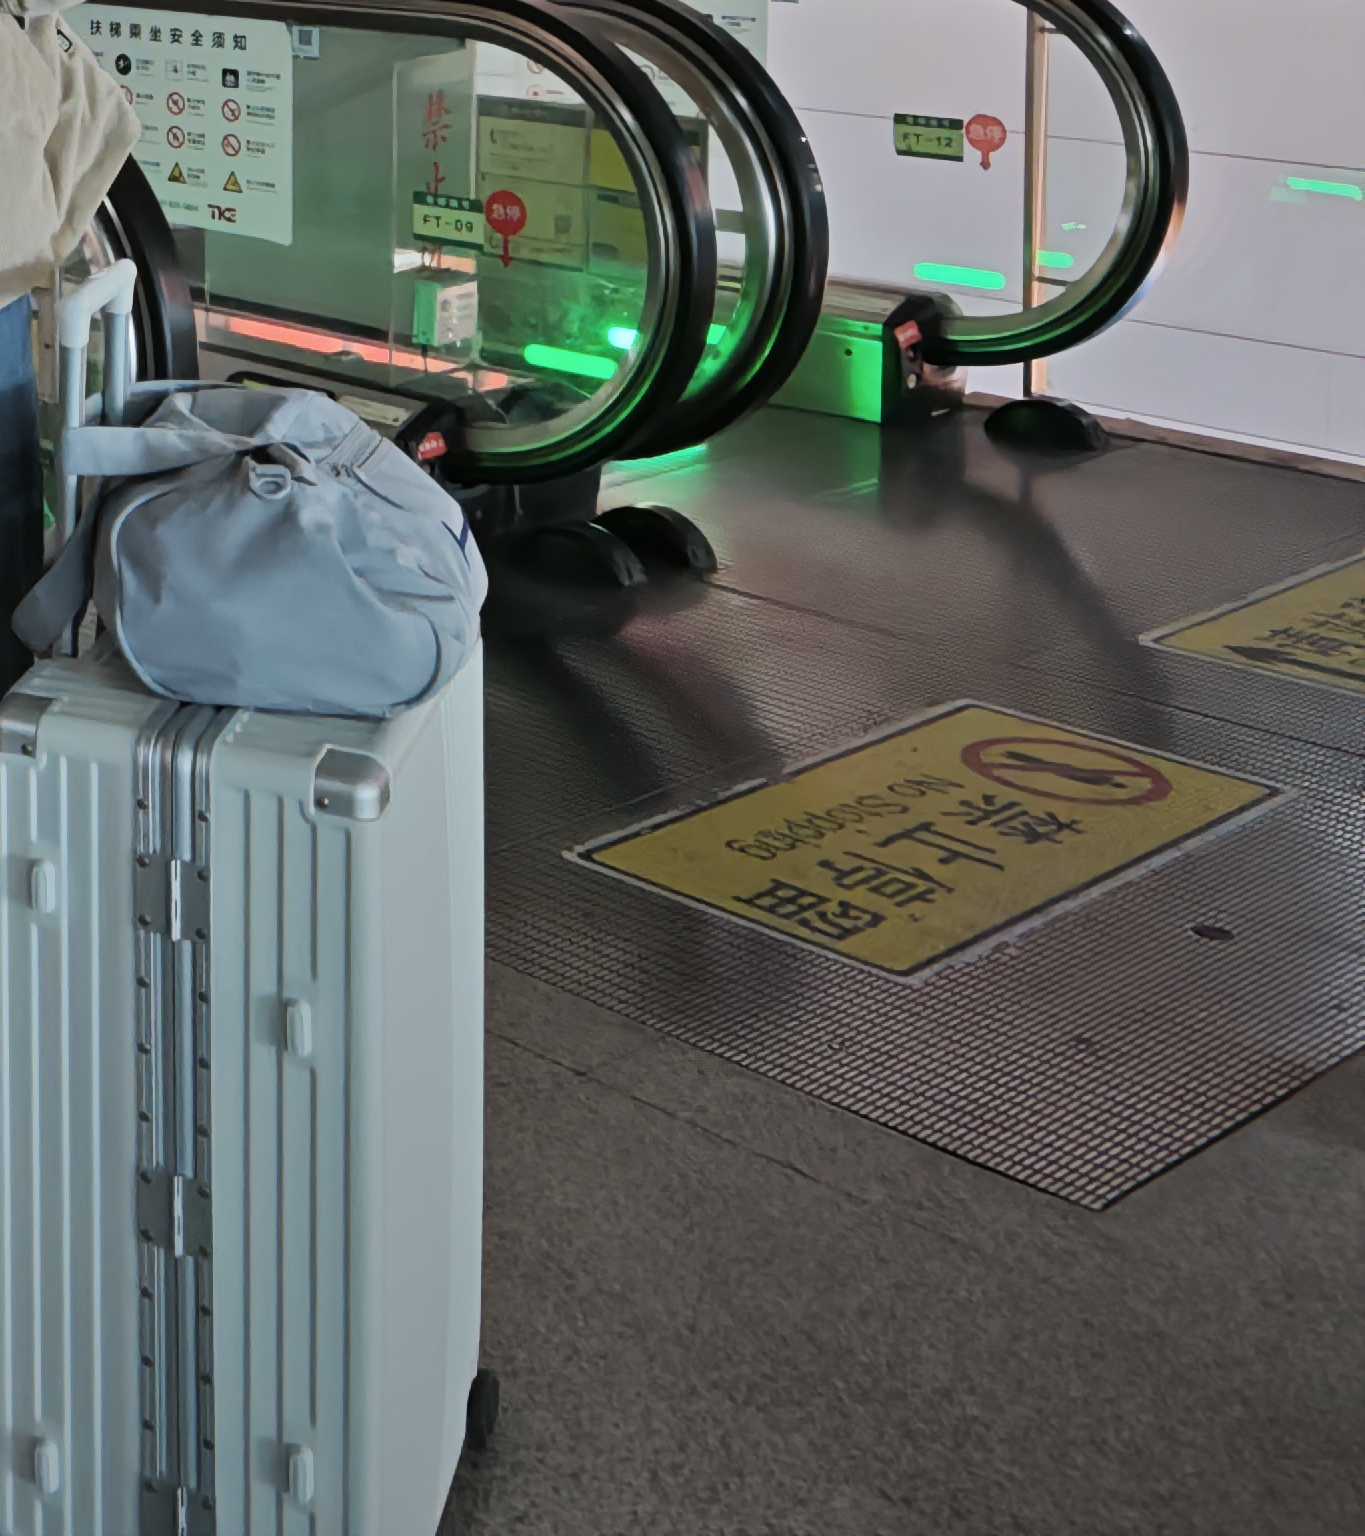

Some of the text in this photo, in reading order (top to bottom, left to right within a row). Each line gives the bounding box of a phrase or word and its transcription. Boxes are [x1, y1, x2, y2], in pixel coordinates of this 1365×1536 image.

[90, 19, 247, 51] 扶梯乘坐安全须知
[490, 202, 522, 222] 急停
[731, 794, 1087, 942] 禁止停留
